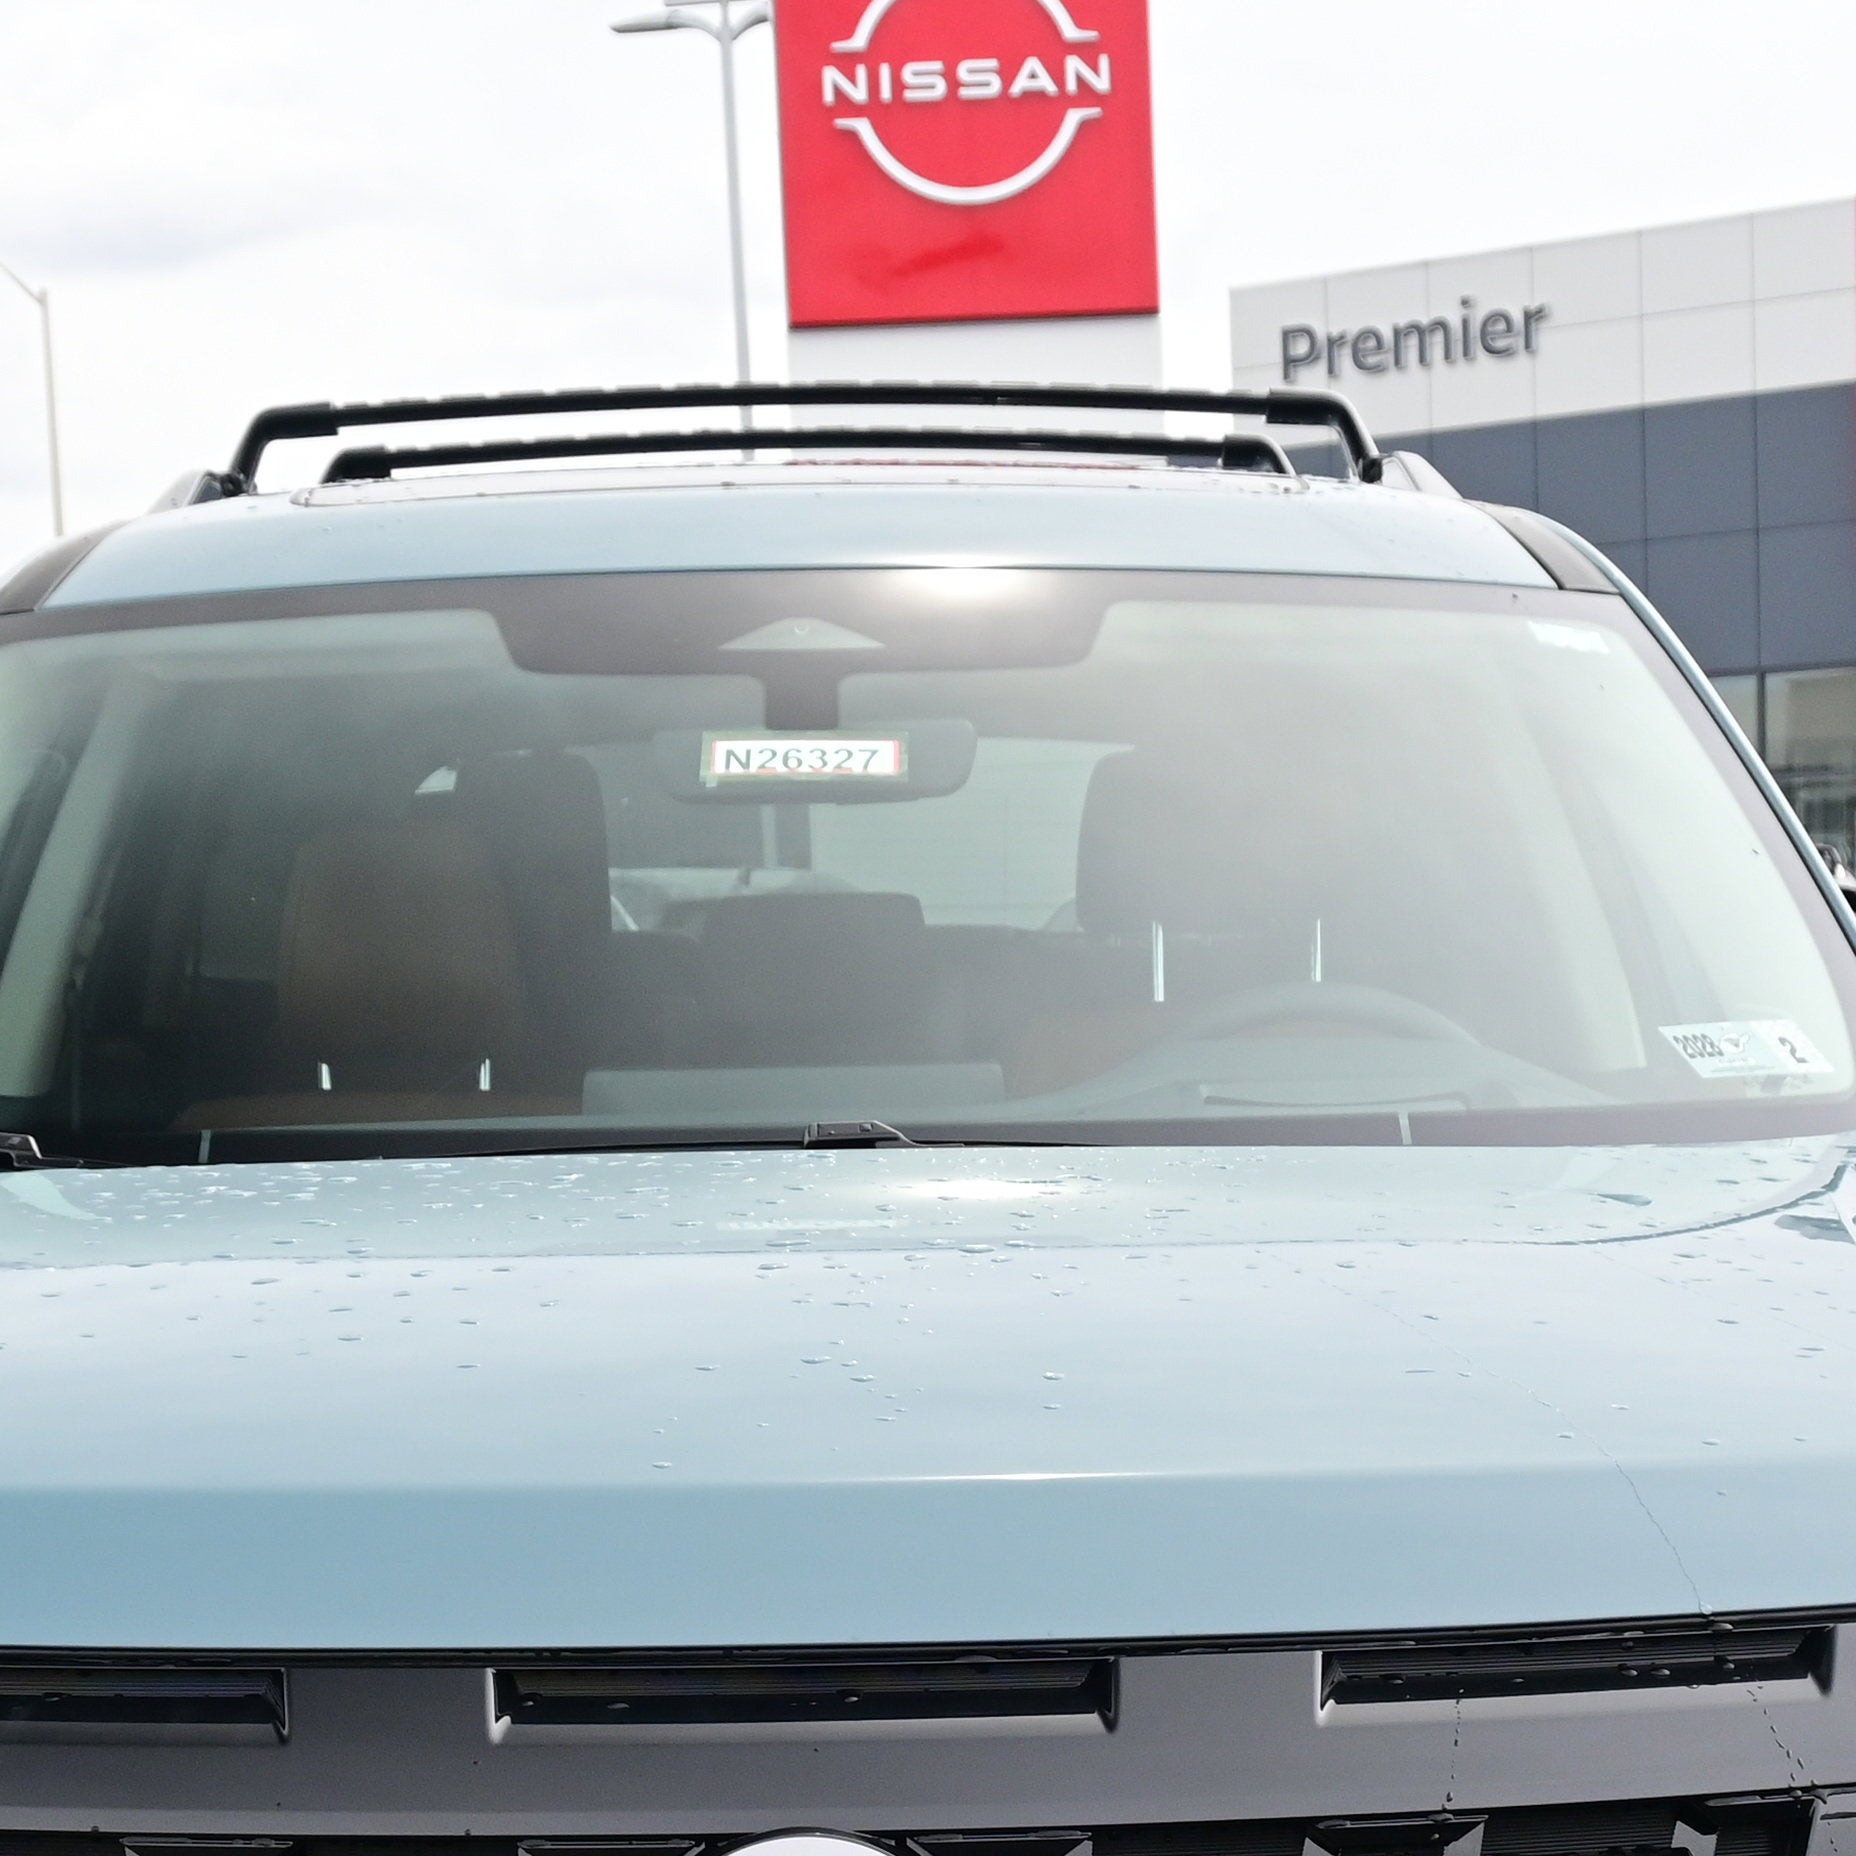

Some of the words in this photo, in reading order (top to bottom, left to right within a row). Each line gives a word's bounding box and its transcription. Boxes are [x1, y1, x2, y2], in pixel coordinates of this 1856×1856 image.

[821, 53, 1112, 106] NISSAN
[1281, 292, 1552, 383] Premier
[724, 748, 880, 771] N26327
[1779, 1036, 1808, 1064] 2
